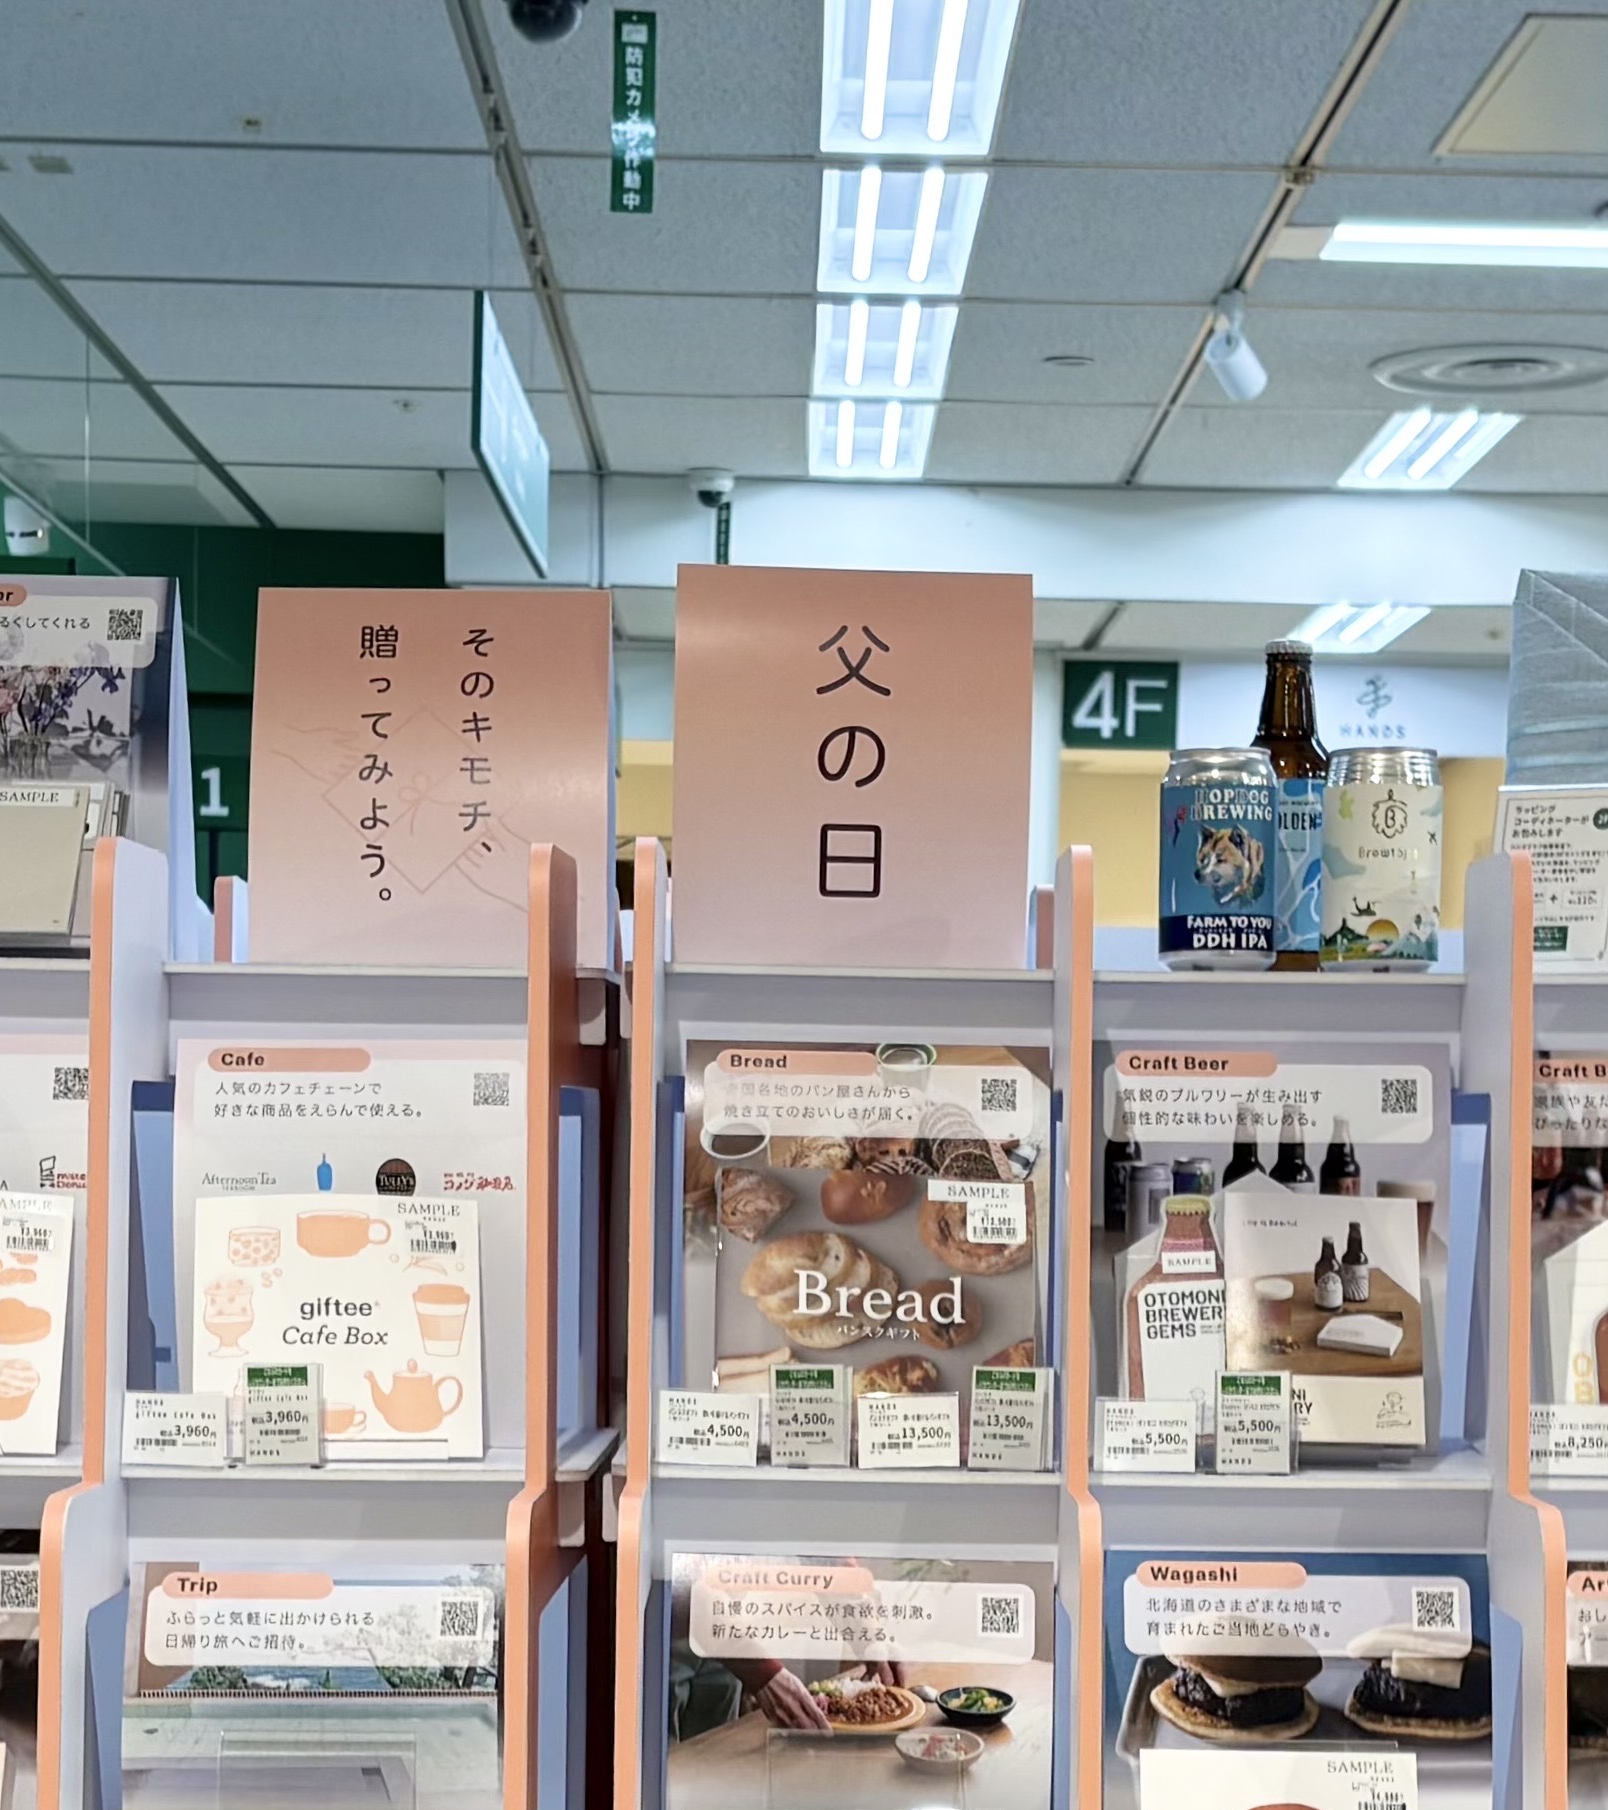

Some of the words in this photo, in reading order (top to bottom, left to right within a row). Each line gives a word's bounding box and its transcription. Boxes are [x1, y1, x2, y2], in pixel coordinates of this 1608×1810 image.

[1071, 669, 1167, 738] 4F
[459, 627, 494, 853] そのキモチ、
[1339, 725, 1407, 739] HANDS
[358, 624, 400, 904] 贈ってみよう。
[815, 624, 892, 898] 父の日
[199, 767, 229, 817] 1
[1192, 803, 1273, 822] BREWING
[1187, 915, 1229, 930] FARM
[1229, 916, 1248, 929] TO
[1249, 916, 1273, 931] YOU
[1192, 932, 1236, 949] DDH
[1241, 933, 1268, 949] IPA
[220, 1052, 265, 1067] Cafe
[730, 1054, 788, 1070] Bread
[1129, 1056, 1179, 1071] Craft
[1184, 1057, 1230, 1071] Beer
[1539, 1063, 1590, 1078] Craft
[215, 1080, 382, 1096] 人気のカフェチェーンで
[1122, 1088, 1323, 1104] 気鋭のブルワリーが生み出す
[214, 1102, 423, 1118] 好きな商品をえらんで使える。
[723, 1105, 914, 1122] 焼き立てのおいしさが届く。
[1122, 1110, 1319, 1127] 個性的な味わいを楽しめる。
[202, 1172, 258, 1187] Afternoon
[258, 1172, 277, 1185] Tea
[947, 1184, 1011, 1200] SAMPLE
[397, 1203, 461, 1217] SAMPLE
[793, 1269, 966, 1325] Bread
[300, 1298, 373, 1319] giftee
[281, 1325, 338, 1346] Cafe
[344, 1326, 389, 1345] Box
[1147, 1323, 1197, 1339] GEMS
[718, 1570, 770, 1586] Craft
[775, 1570, 834, 1589] Curry
[1150, 1565, 1239, 1584] Wagashi
[177, 1577, 219, 1595] Trip
[712, 1600, 935, 1621] 自慢のスパイスが食欲を刺激。
[1146, 1598, 1342, 1615] 北海道のさまざまな地域で
[165, 1610, 376, 1628] ふらっと気軽に出かけられる
[712, 1624, 896, 1642] 新たなカレーと出合える。
[1146, 1620, 1331, 1639] 育まれたご当地どらやき。
[165, 1632, 307, 1651] 日帰り旅へご招待。
[1327, 1761, 1394, 1775] SAMPLE
